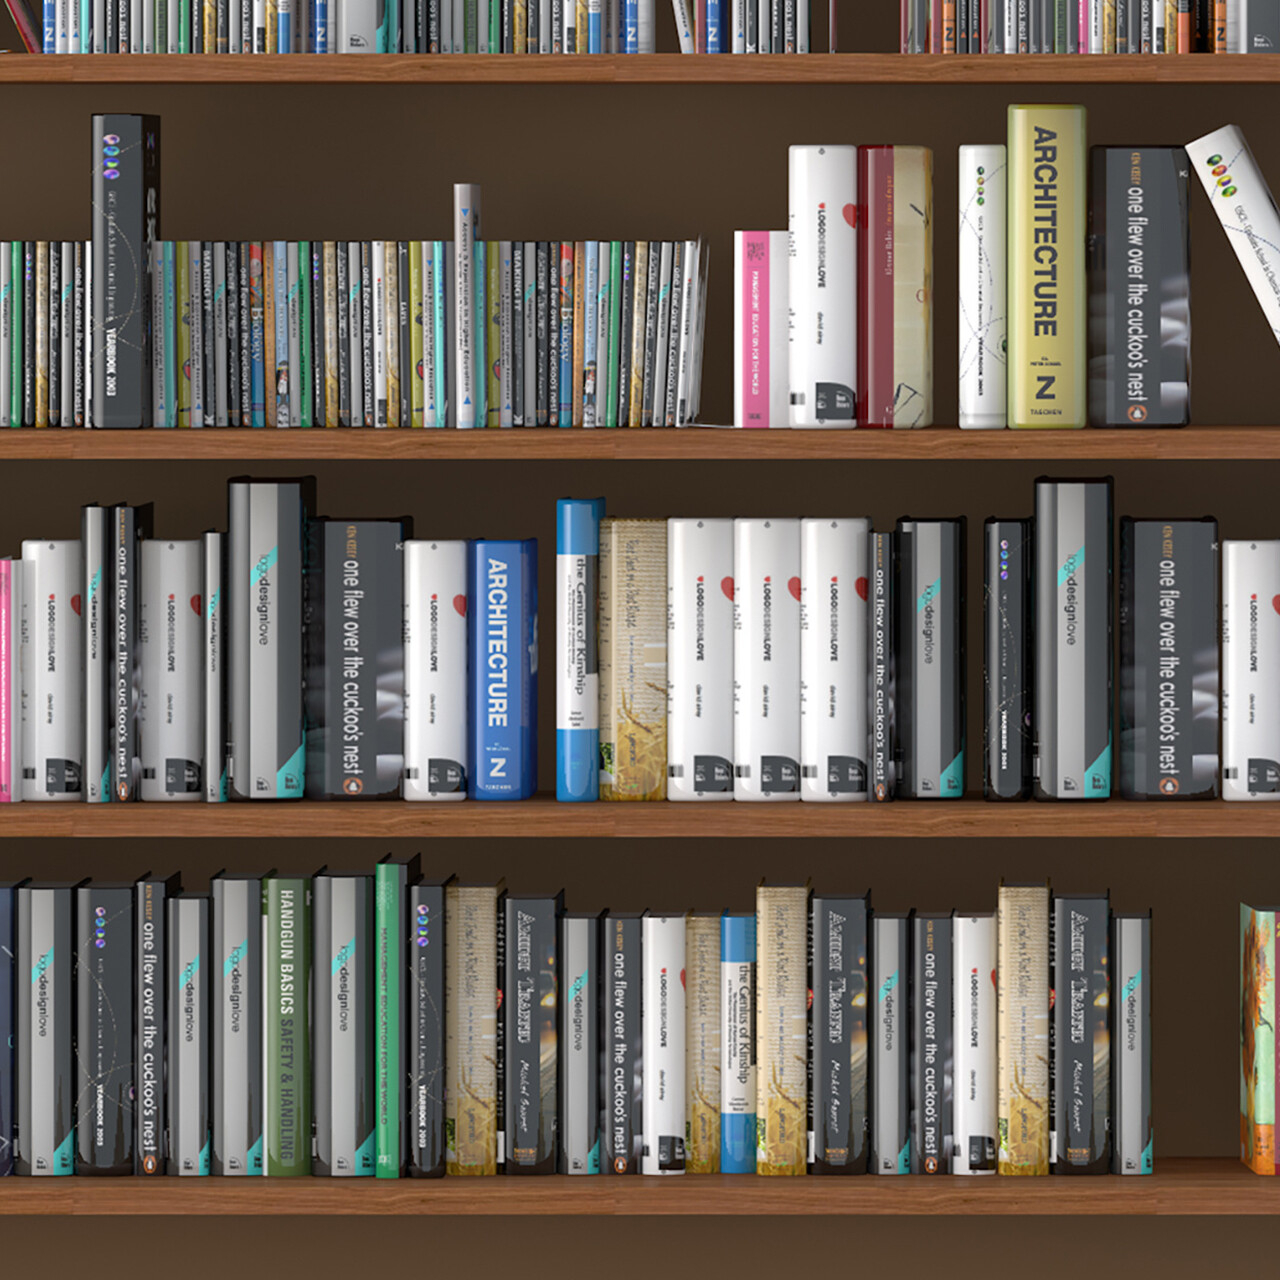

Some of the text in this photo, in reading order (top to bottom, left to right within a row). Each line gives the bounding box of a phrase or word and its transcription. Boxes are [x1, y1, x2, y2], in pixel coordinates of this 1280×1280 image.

[1127, 187, 1142, 213] one
[1034, 126, 1057, 336] ARCHITECTURE
[1127, 217, 1148, 245] flew
[1127, 248, 1142, 279] over
[1127, 284, 1148, 305] the
[251, 307, 264, 362] Biology
[559, 307, 573, 362] Biology
[1127, 309, 1148, 369] cuckoo's
[1036, 376, 1055, 400] N
[1127, 373, 1146, 401] nest
[343, 560, 358, 586] one
[343, 589, 364, 619] flew
[575, 559, 586, 695] the Genius of Kinship
[118, 547, 128, 778] one flew over the cuckoo's nest
[343, 622, 358, 651] over
[488, 558, 507, 727] ARCHITECTURE
[343, 657, 364, 678] the
[1159, 560, 1180, 774] one flew over the cuckoo's nest
[343, 682, 364, 741] cuckoo's
[343, 745, 362, 774] nest
[489, 757, 506, 777] N
[143, 923, 157, 1151] one flew over the cuckoo's nest
[280, 890, 294, 1159] HANDGUN BASICS SAFETY & HANDLING
[737, 965, 750, 1083] the Genius of Kinship
[924, 953, 938, 1154] one flew over the cuckoo's nest
